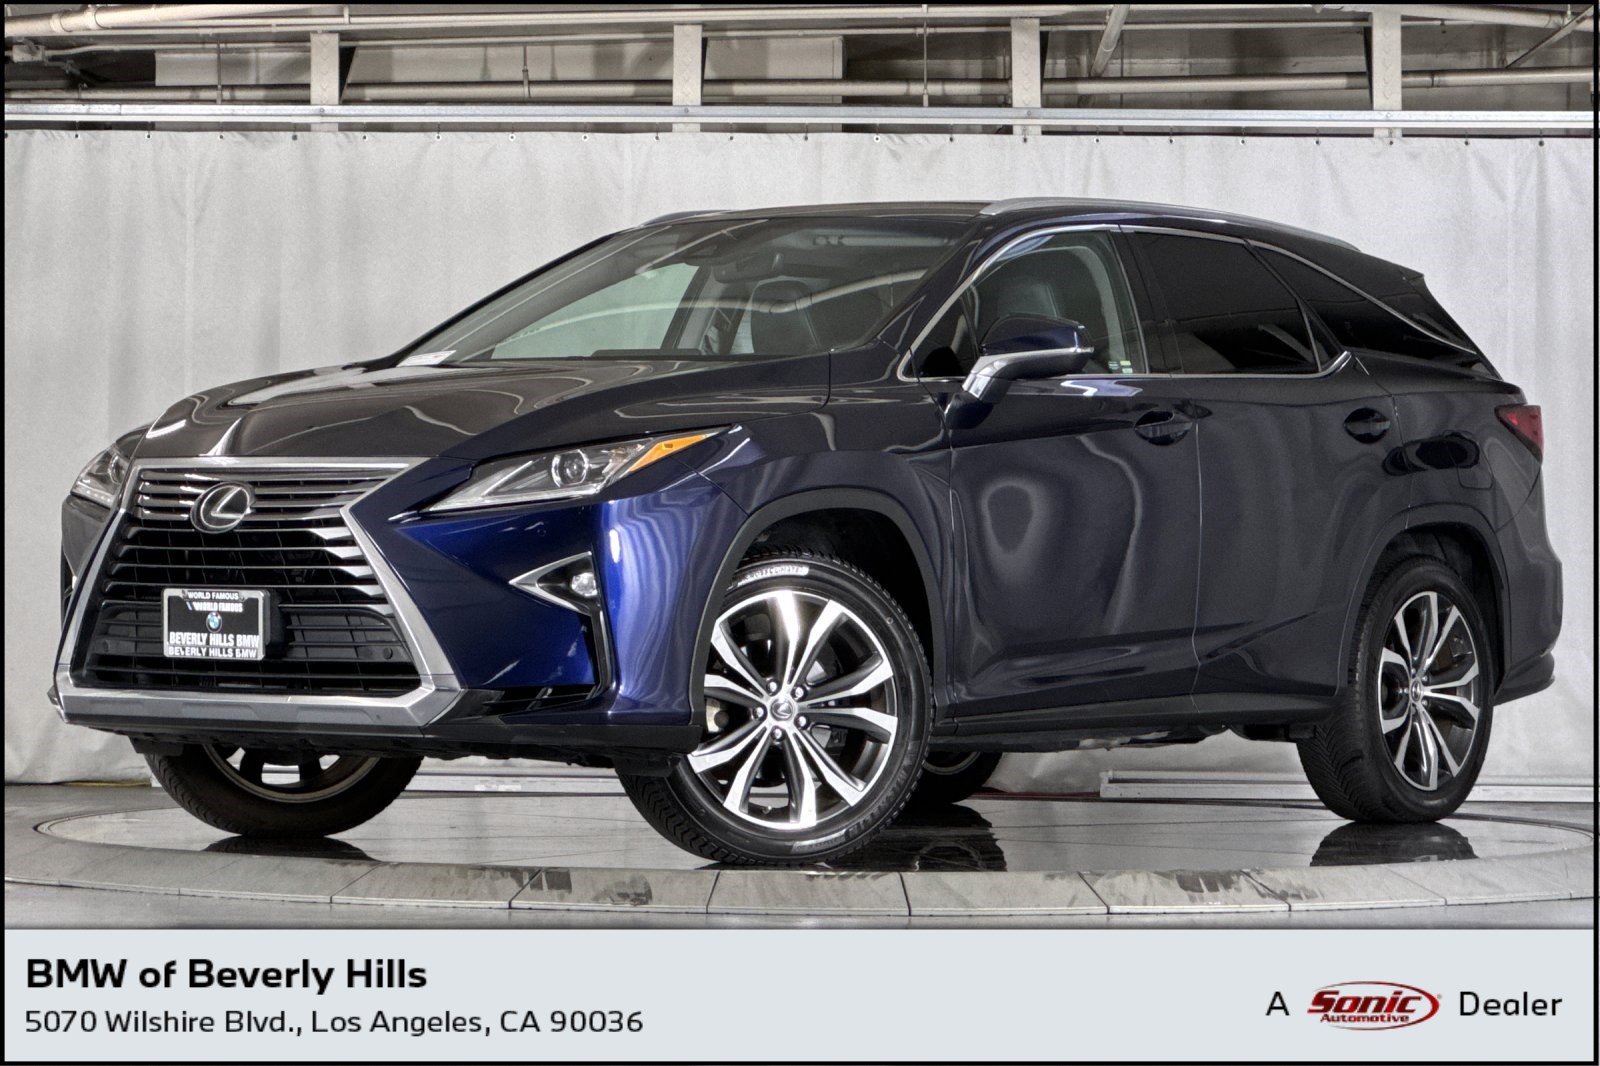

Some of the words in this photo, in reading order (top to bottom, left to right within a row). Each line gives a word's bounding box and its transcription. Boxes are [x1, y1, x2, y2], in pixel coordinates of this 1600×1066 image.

[188, 592, 210, 600] WORLD
[212, 592, 239, 600] FAMOUS
[219, 603, 243, 612] FAMOUS
[169, 632, 208, 645] BEVERLY
[209, 634, 234, 647] HILLS
[236, 635, 259, 648] BMW
[169, 647, 207, 657] BEVERLY
[209, 648, 234, 657] HILLS
[235, 649, 257, 658] BMW
